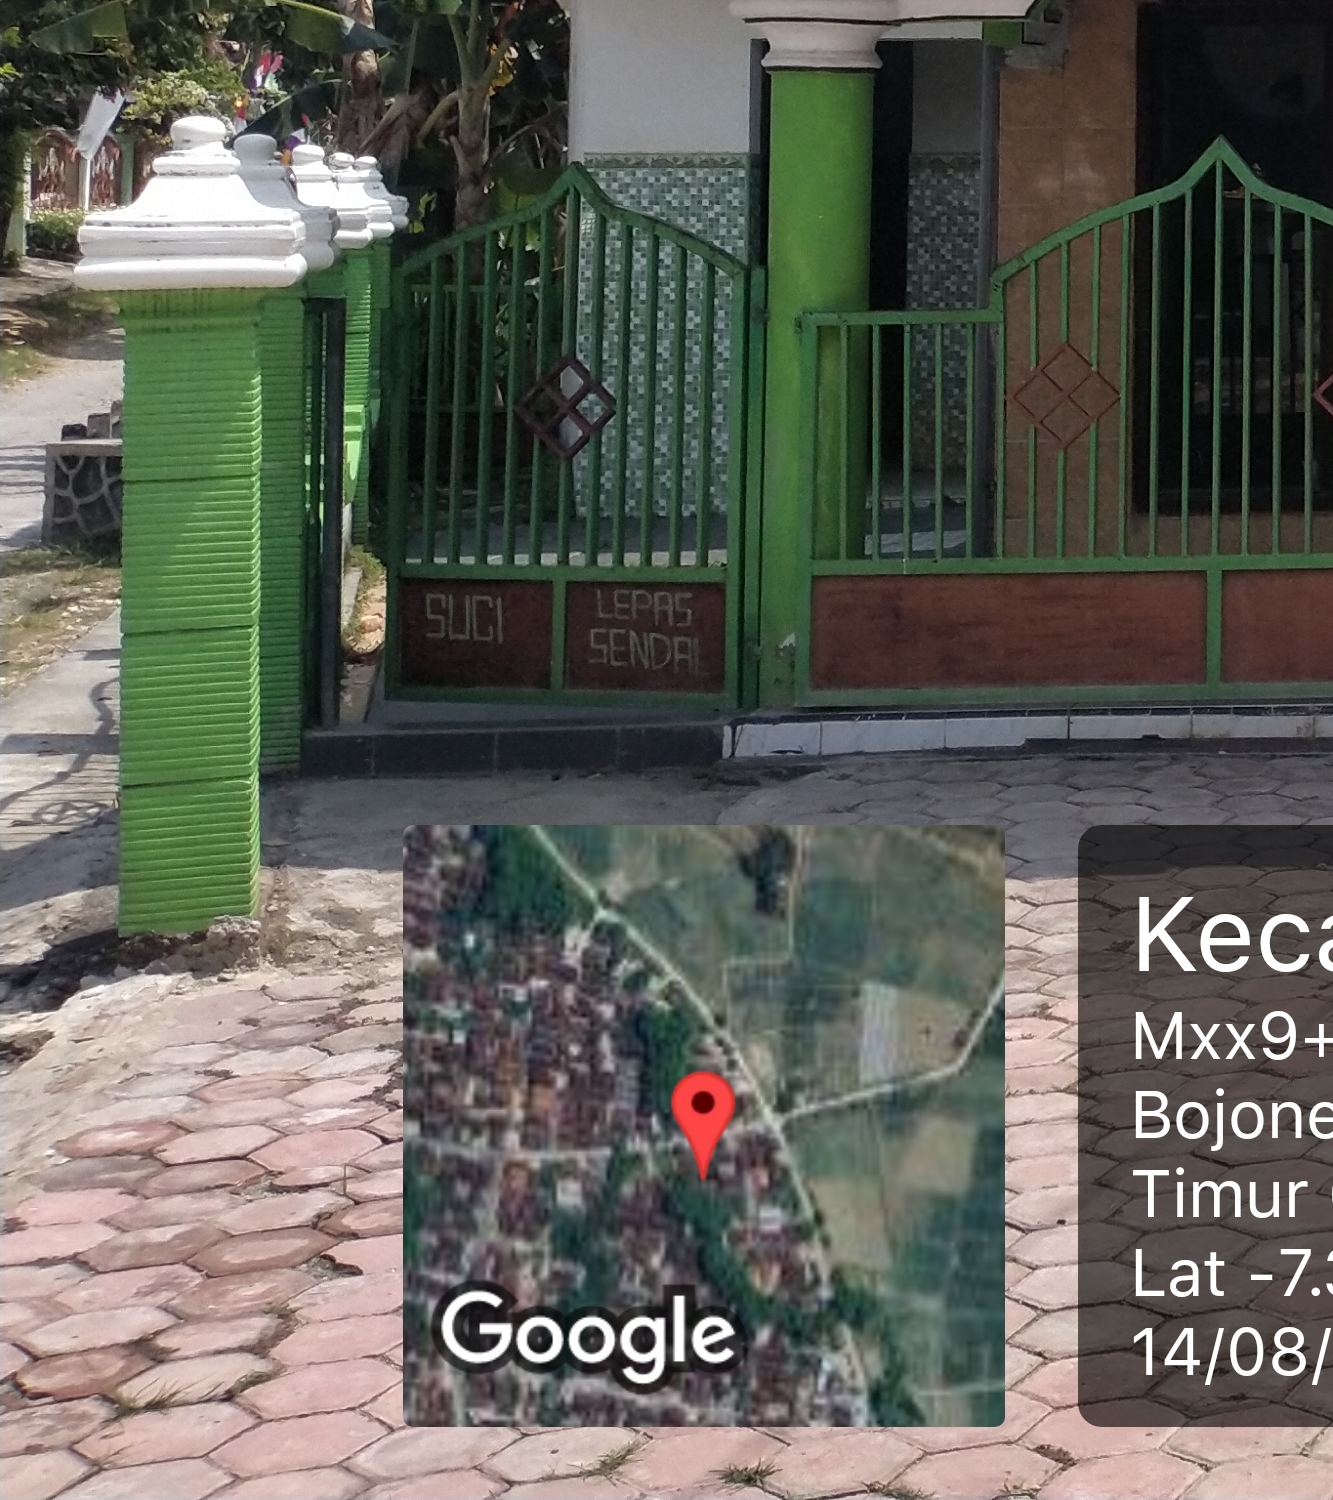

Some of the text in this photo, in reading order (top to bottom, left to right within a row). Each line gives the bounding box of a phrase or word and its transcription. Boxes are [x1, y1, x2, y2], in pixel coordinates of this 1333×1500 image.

[425, 592, 504, 644] SUCI
[596, 588, 693, 627] LEPAS
[588, 628, 709, 675] SENDAL
